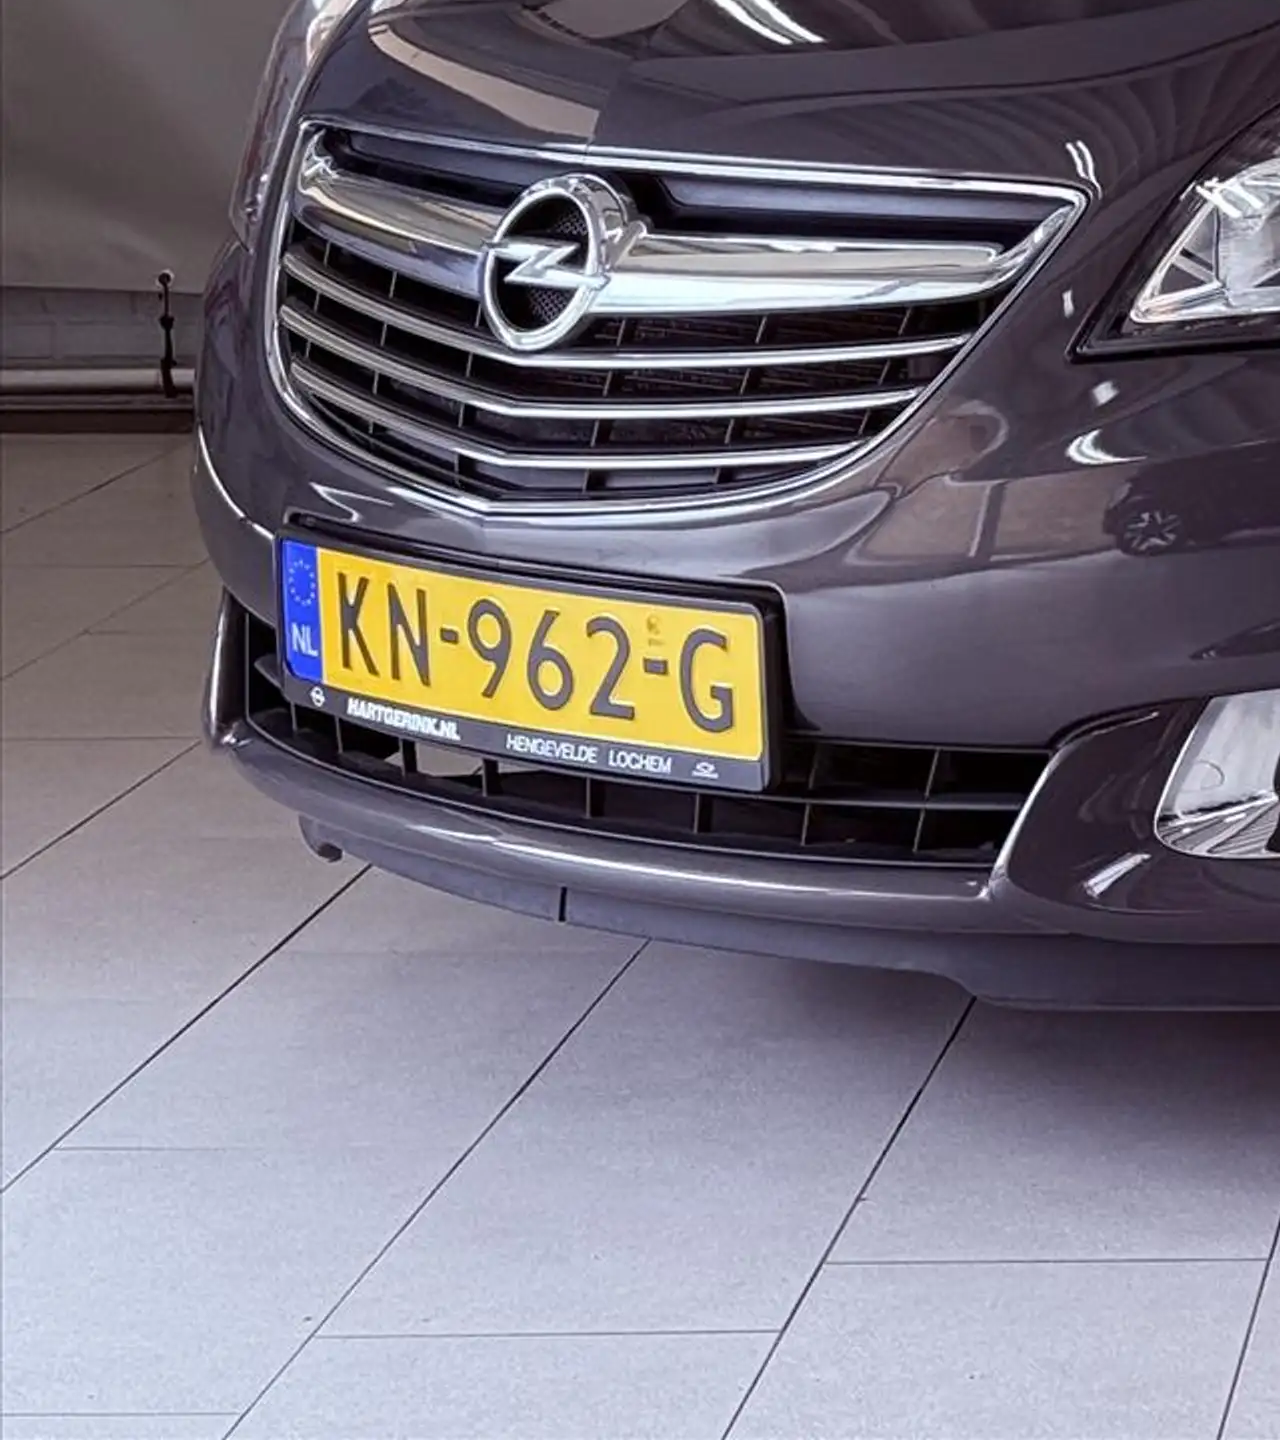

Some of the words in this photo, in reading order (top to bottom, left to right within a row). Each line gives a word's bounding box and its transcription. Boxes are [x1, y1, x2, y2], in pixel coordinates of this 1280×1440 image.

[291, 623, 319, 657] NL
[337, 572, 735, 734] KN-962-G
[347, 697, 461, 741] HARTGERINK.NL
[506, 733, 598, 764] HENGEVELDE
[608, 750, 673, 774] LOCHEM
